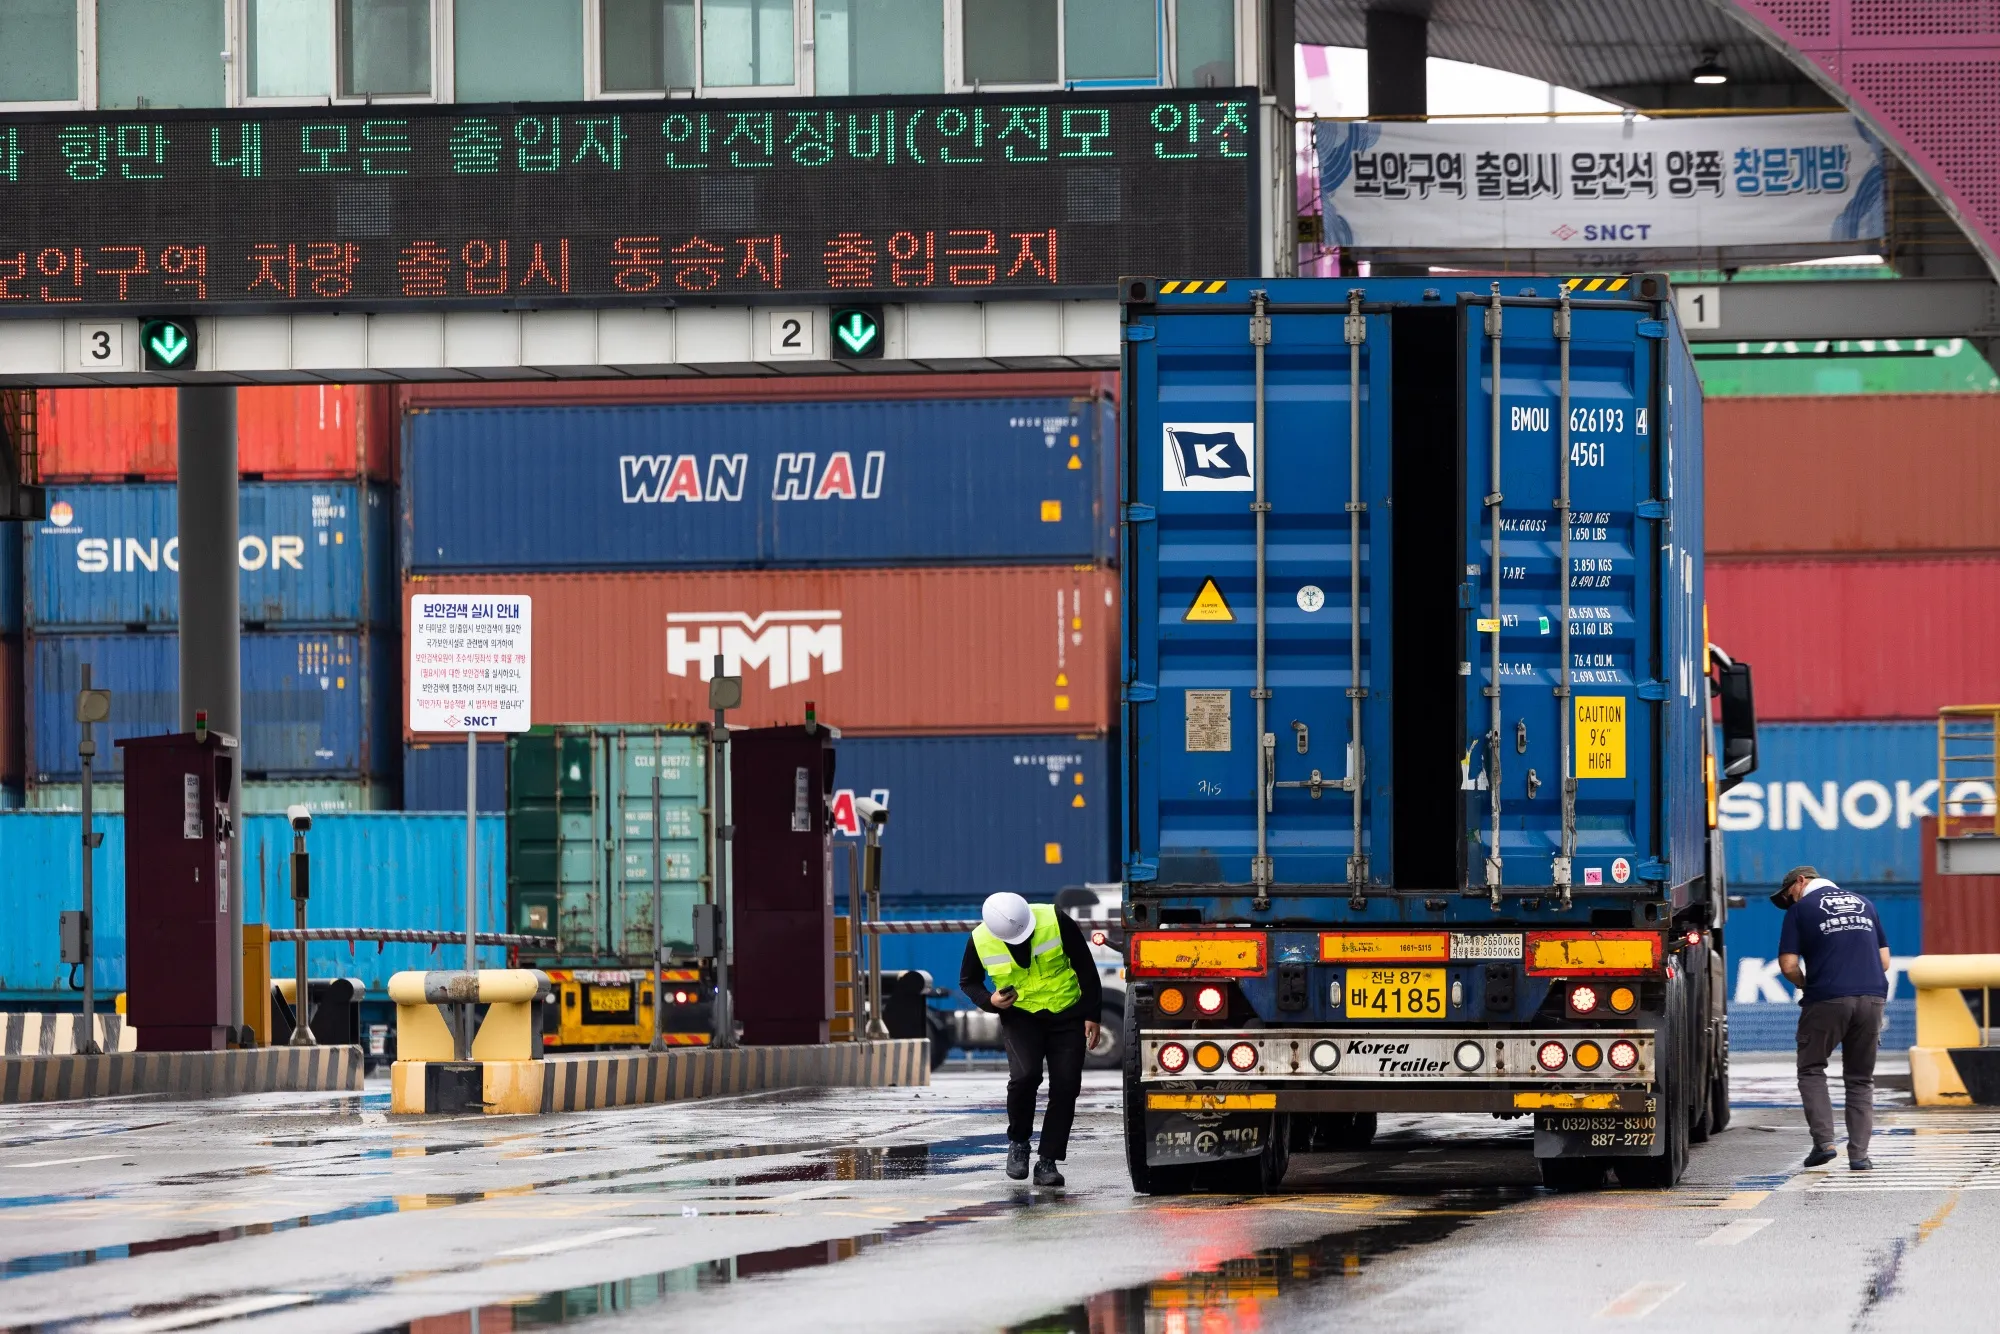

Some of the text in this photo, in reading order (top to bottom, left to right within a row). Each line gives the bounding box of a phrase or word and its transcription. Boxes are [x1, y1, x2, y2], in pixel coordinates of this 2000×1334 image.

[58, 125, 171, 180] 항만
[211, 122, 262, 177] 내
[299, 119, 411, 175] 모든
[449, 115, 628, 174] 출입자
[1352, 145, 1850, 199] 보안구역 출입시 운전석 양쪽 창문개방
[1583, 224, 1652, 241] SNCT
[247, 241, 360, 298] 차량
[398, 238, 570, 297] 출입시
[610, 234, 790, 293] 동승자
[822, 228, 1059, 289] 출입금지
[1692, 293, 1705, 323] 1
[781, 319, 802, 348] 2
[91, 330, 112, 361] 3
[1511, 406, 1647, 434] BMOU 626193 4
[1193, 443, 1231, 469] K
[1570, 442, 1605, 467] 45G1
[619, 451, 886, 504] WAN HAI
[1595, 512, 1611, 524] KGS
[1568, 528, 1607, 541] 1.650 LBS
[76, 534, 305, 573] SINOR
[1503, 559, 1613, 580] TARE 3.850 KGS
[1571, 575, 1612, 588] 8.490 LBS
[423, 603, 519, 619] 보안검색 실시 안내
[1502, 614, 1519, 627] NET
[1594, 607, 1611, 619] KGS
[1570, 622, 1613, 635] 63.160 LBS
[666, 611, 843, 690] HMM
[1574, 654, 1592, 667] 76.4
[1594, 654, 1615, 667] CU.M.
[1571, 671, 1595, 683] 2.698
[463, 716, 498, 727] SNCT
[1578, 705, 1622, 723] CAUTION
[1588, 753, 1612, 770] HIGH
[1371, 971, 1421, 984] 전남 87
[1346, 1040, 1410, 1054] Korea
[1378, 1057, 1451, 1072] Trailer
[1562, 1116, 1657, 1131] 032)832-8300
[1591, 1133, 1657, 1146] 887-2727
